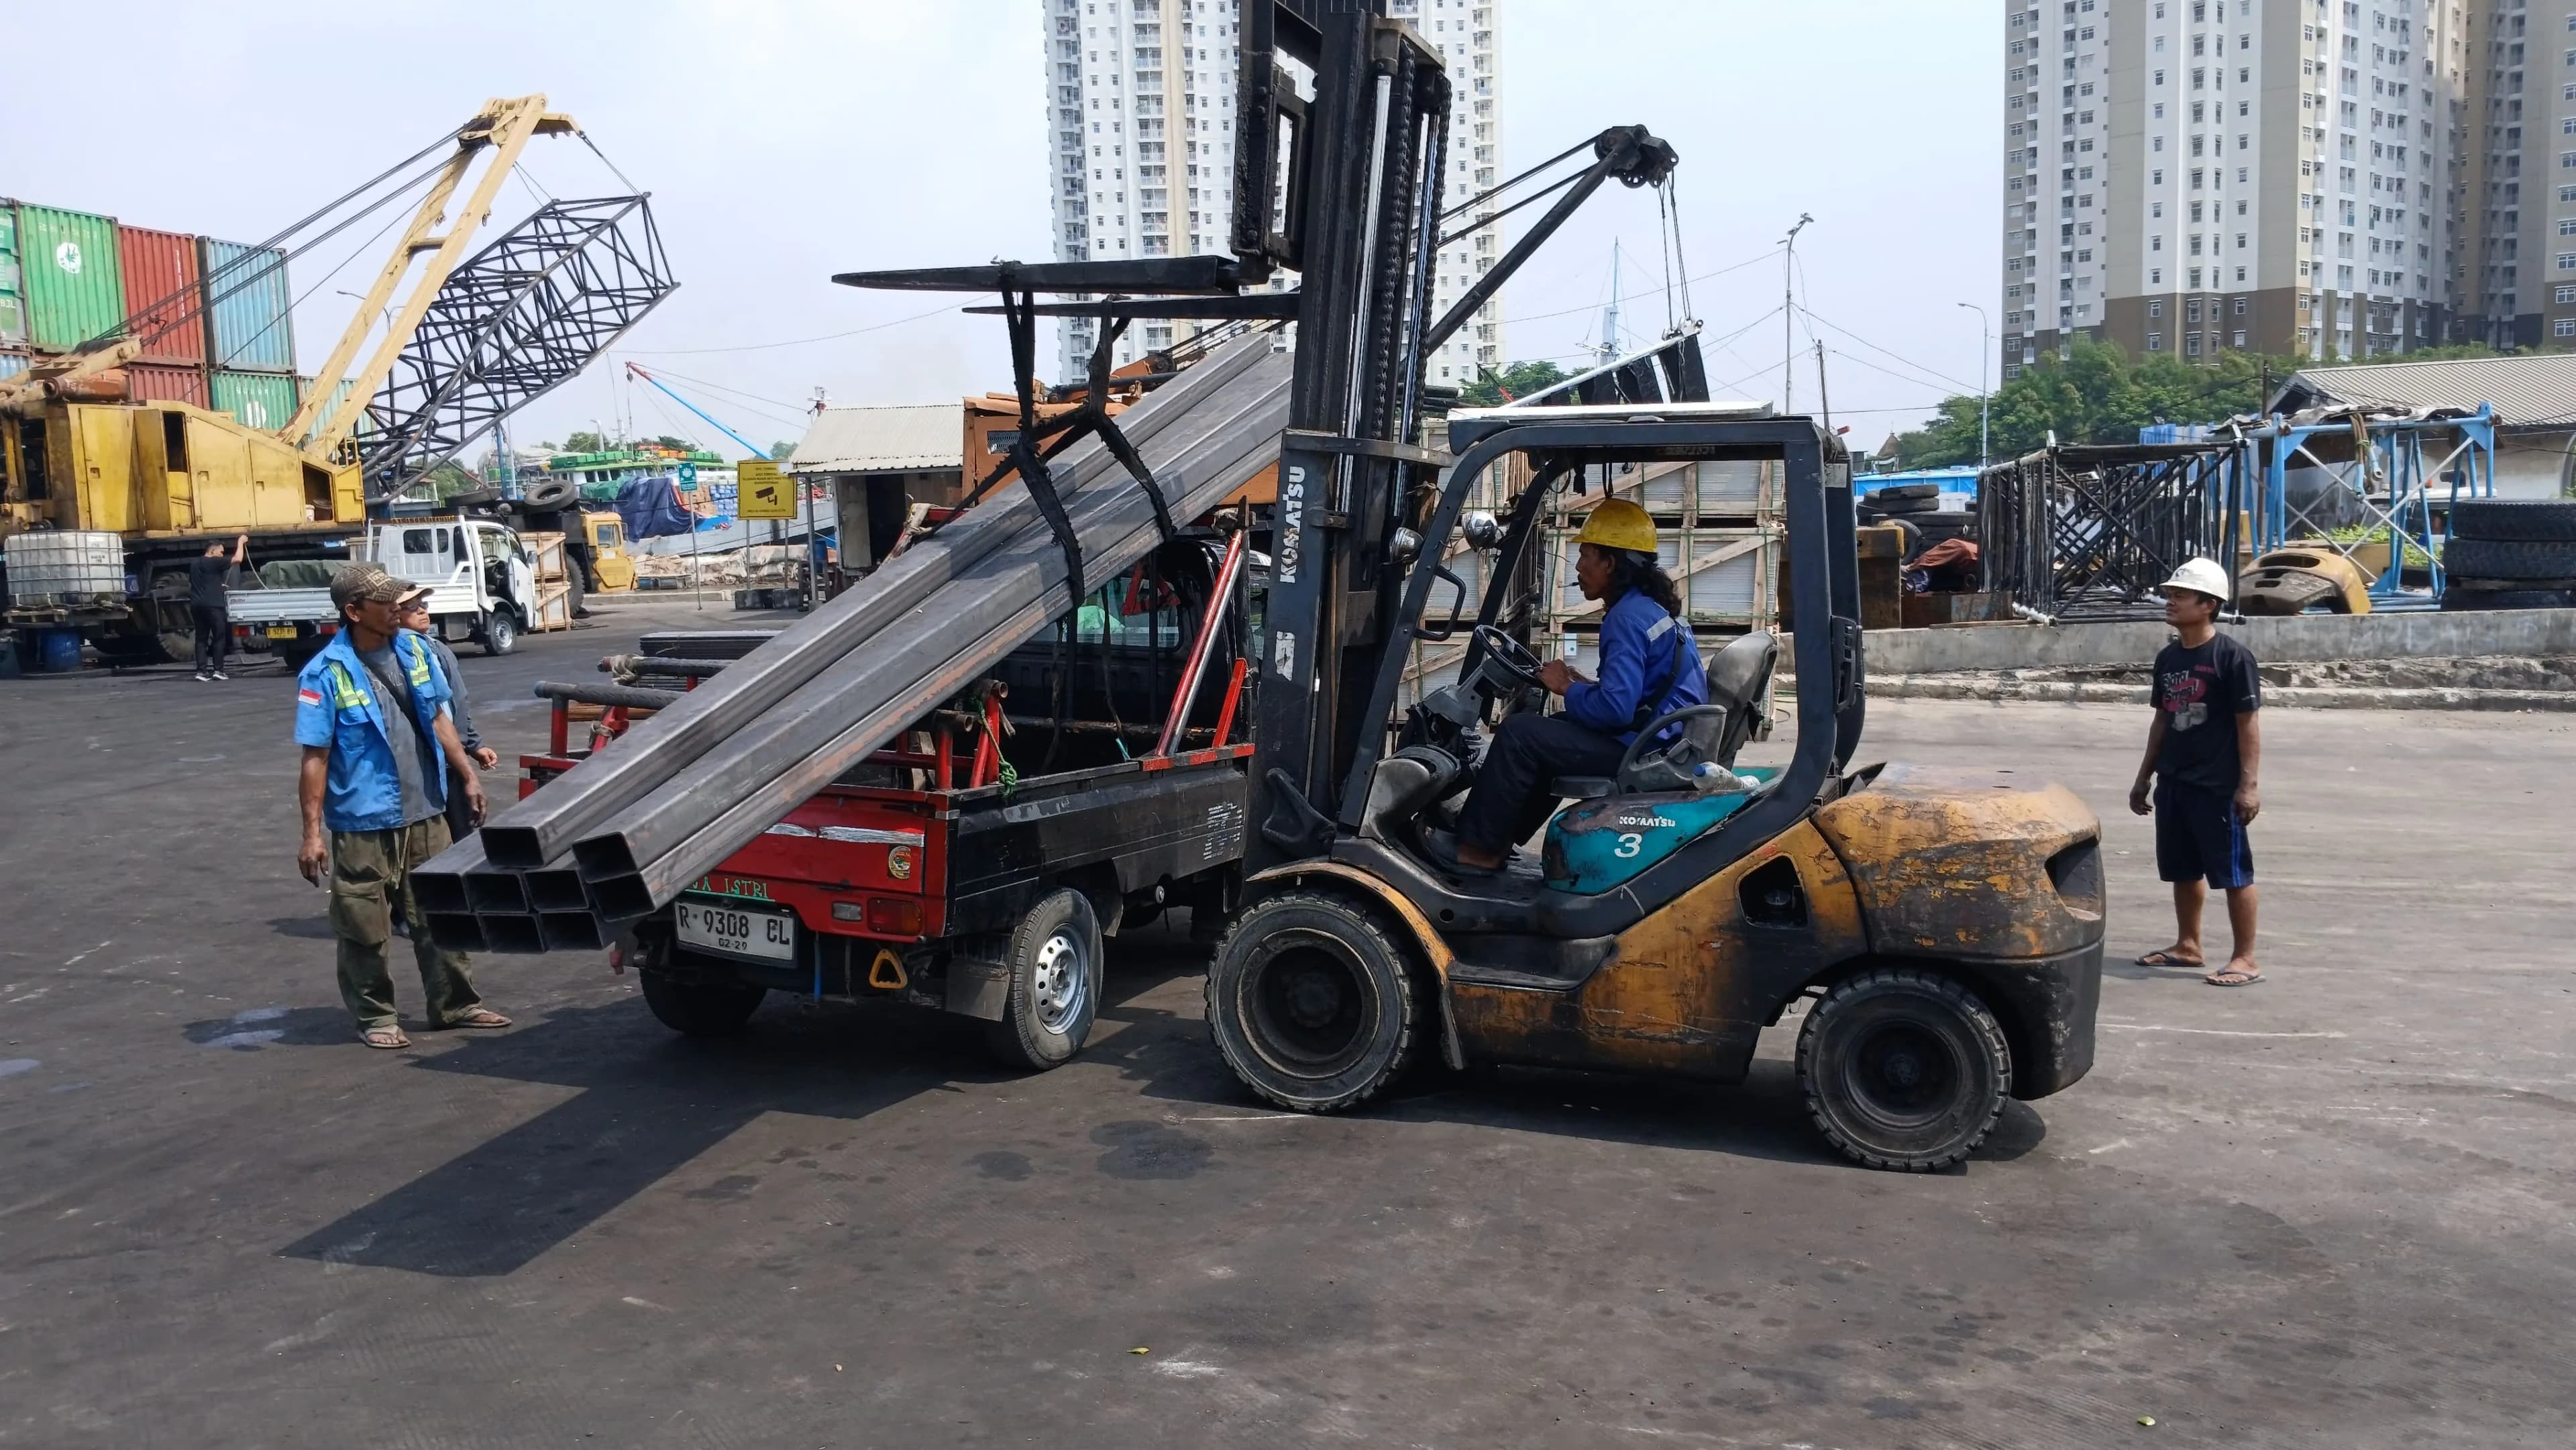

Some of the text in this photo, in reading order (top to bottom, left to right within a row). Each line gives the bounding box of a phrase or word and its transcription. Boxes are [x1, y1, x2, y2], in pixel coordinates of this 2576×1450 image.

[1279, 466, 1305, 583] KOMATSU
[1619, 815, 1676, 827] KOMATSU
[1614, 833, 1642, 858] 3
[724, 878, 768, 899] ISTRI
[679, 905, 790, 945] R 9308 CL
